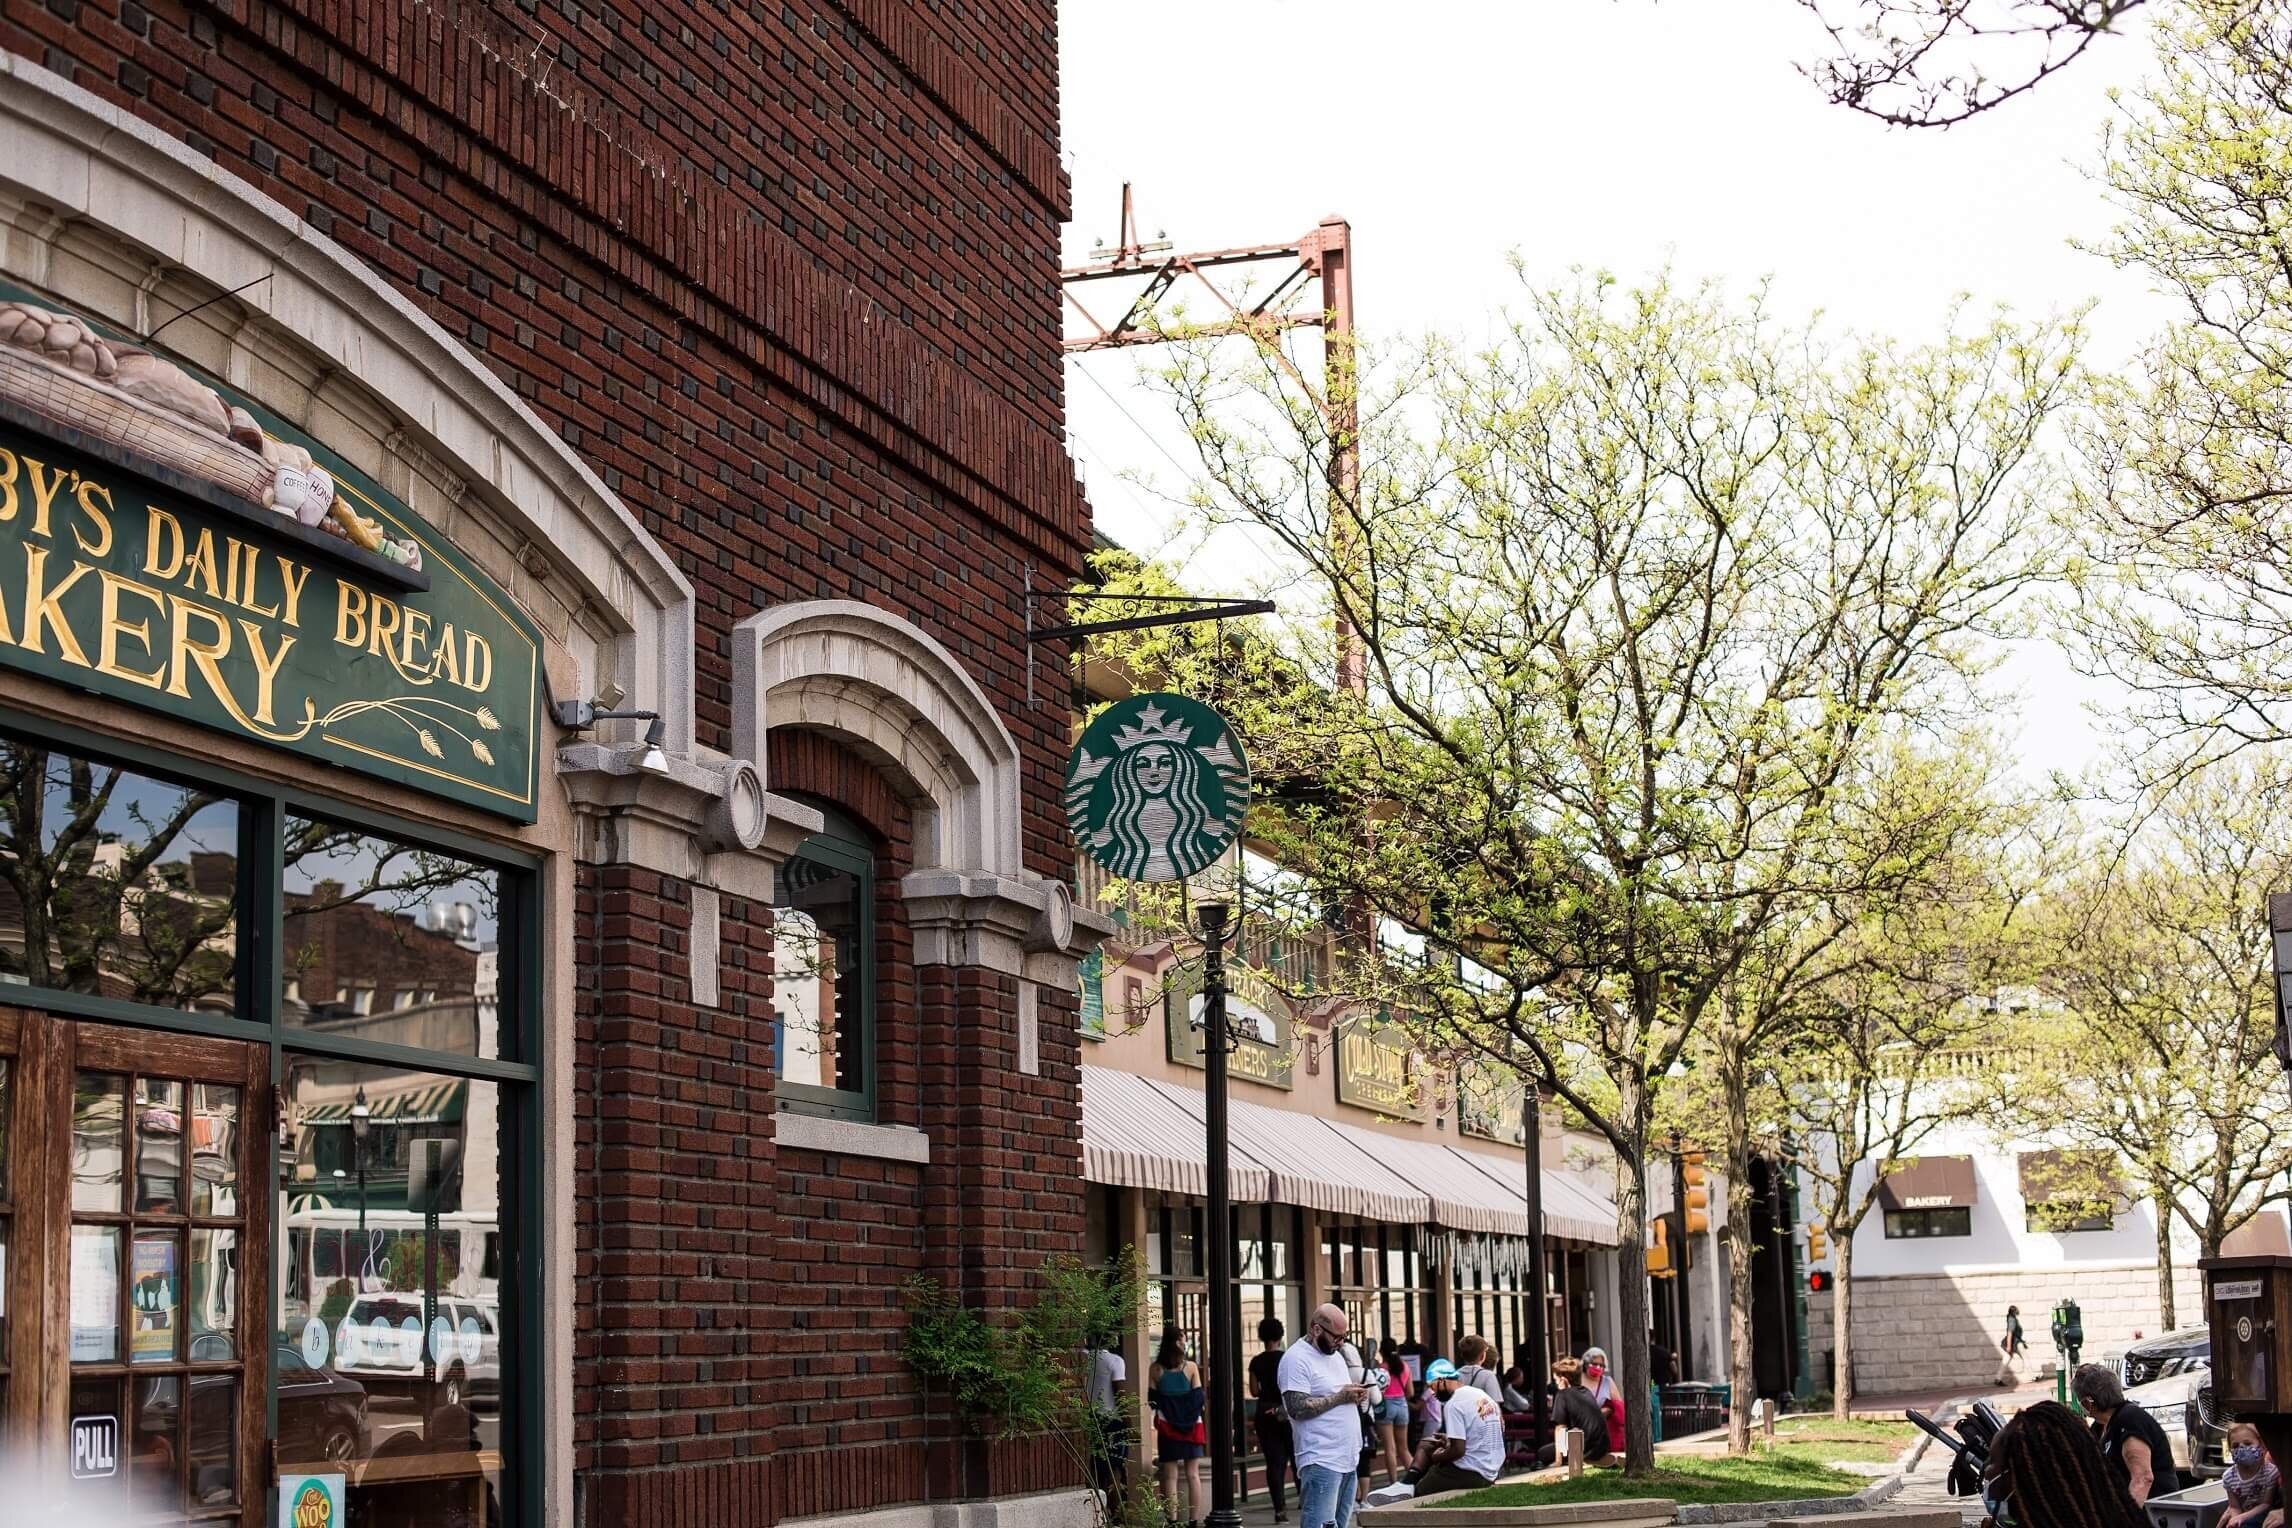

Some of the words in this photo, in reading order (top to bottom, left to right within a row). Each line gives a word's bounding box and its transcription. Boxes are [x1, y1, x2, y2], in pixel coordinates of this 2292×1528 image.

[142, 504, 312, 628] DAILY
[333, 578, 492, 693] BREAD
[1905, 1195, 1952, 1208] BAKERY
[75, 1426, 113, 1470] PULL
